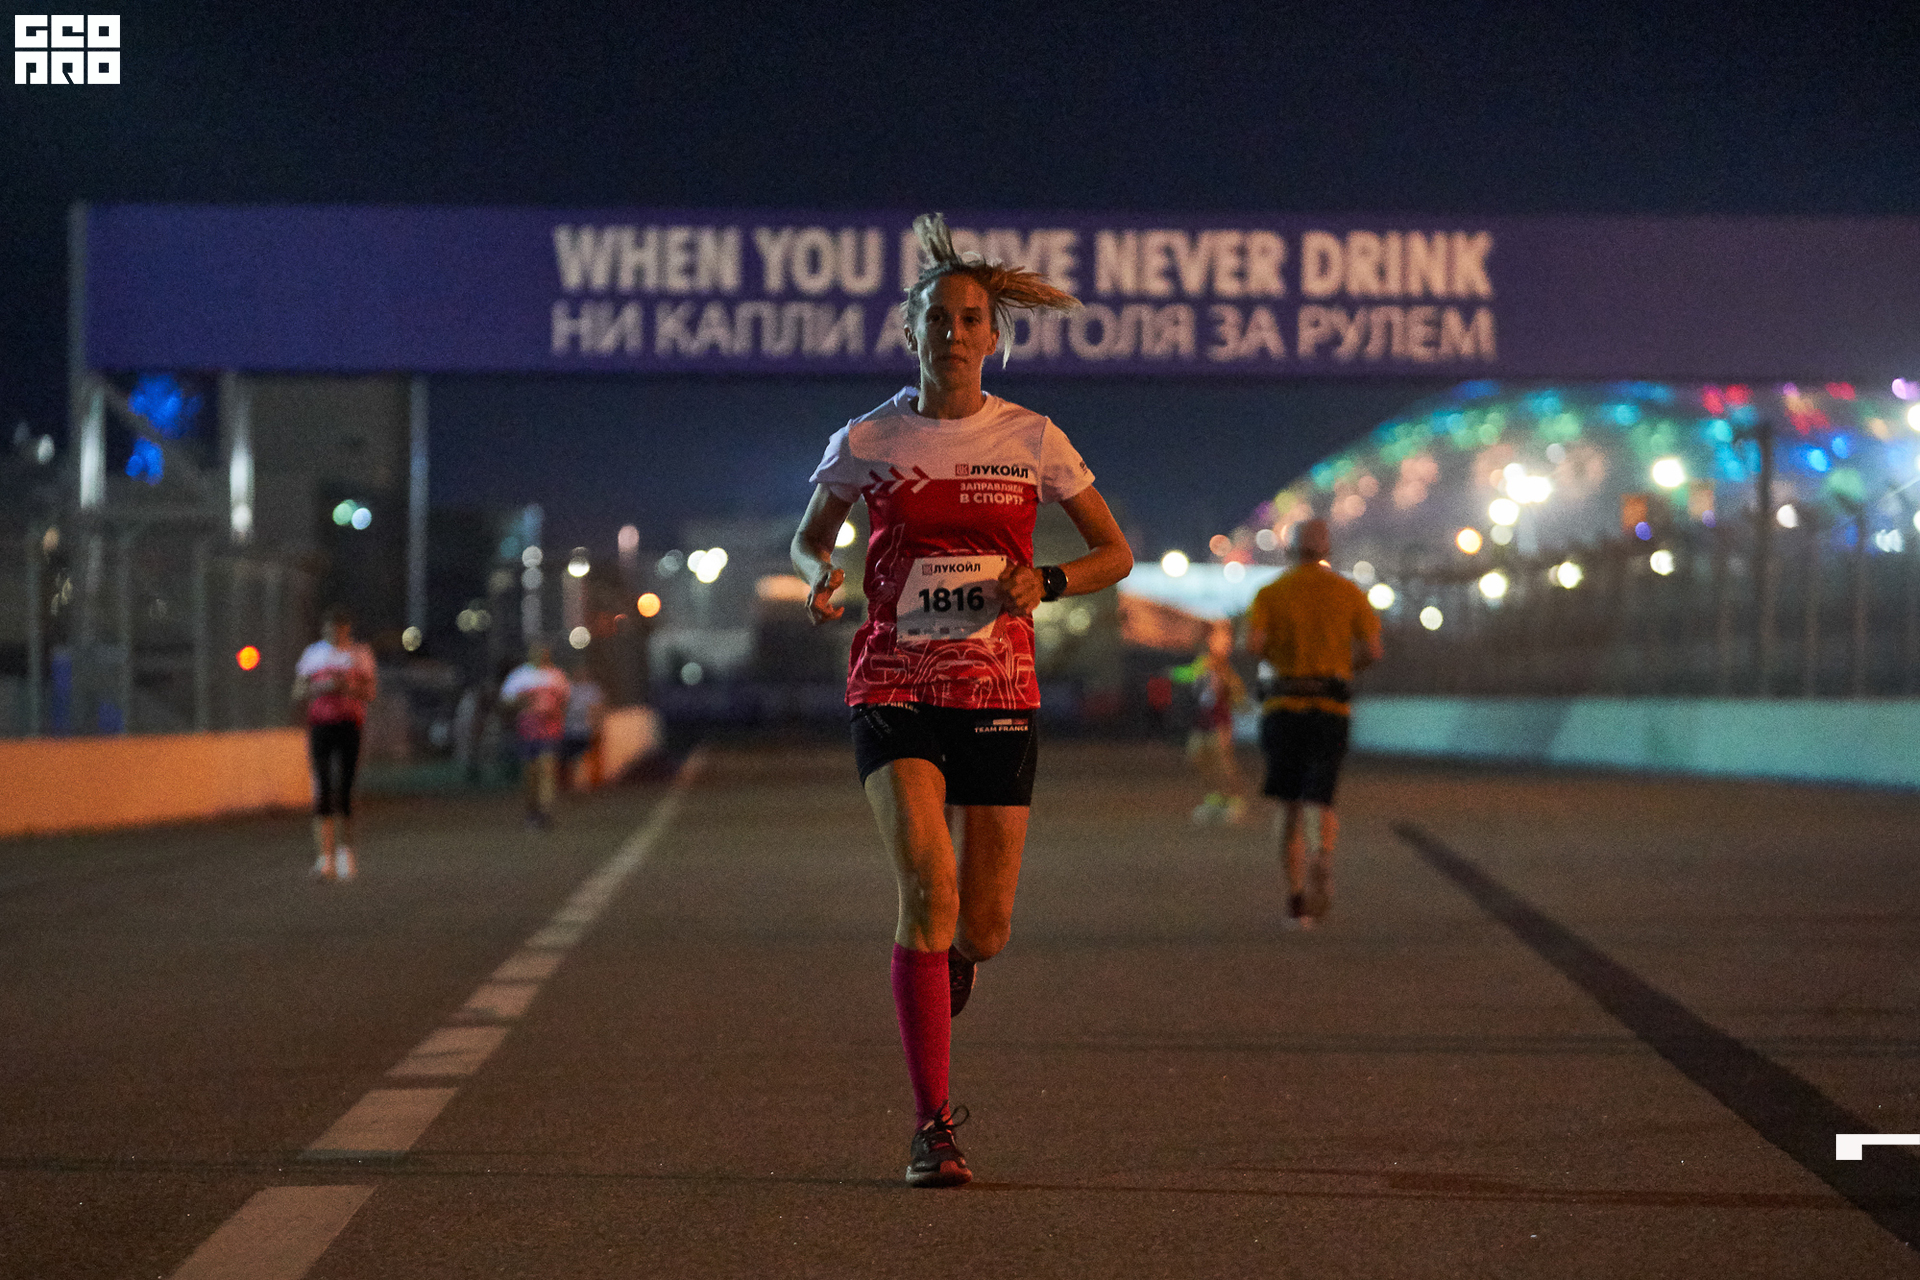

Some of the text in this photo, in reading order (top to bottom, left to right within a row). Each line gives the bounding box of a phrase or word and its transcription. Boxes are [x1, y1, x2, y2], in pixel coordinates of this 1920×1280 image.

[554, 225, 741, 294] WHEN
[754, 227, 884, 294] YOU
[1095, 230, 1286, 295] NEVER
[1302, 231, 1493, 297] DRINK
[551, 301, 1496, 361] НИ КАПЛИ АОГОЛЯ ЗА РУЛЕМ
[970, 464, 1029, 479] ЛУКОЙЛ
[960, 493, 970, 504] В
[933, 562, 981, 573] ЛУКОЙЛ
[919, 586, 985, 612] 1816
